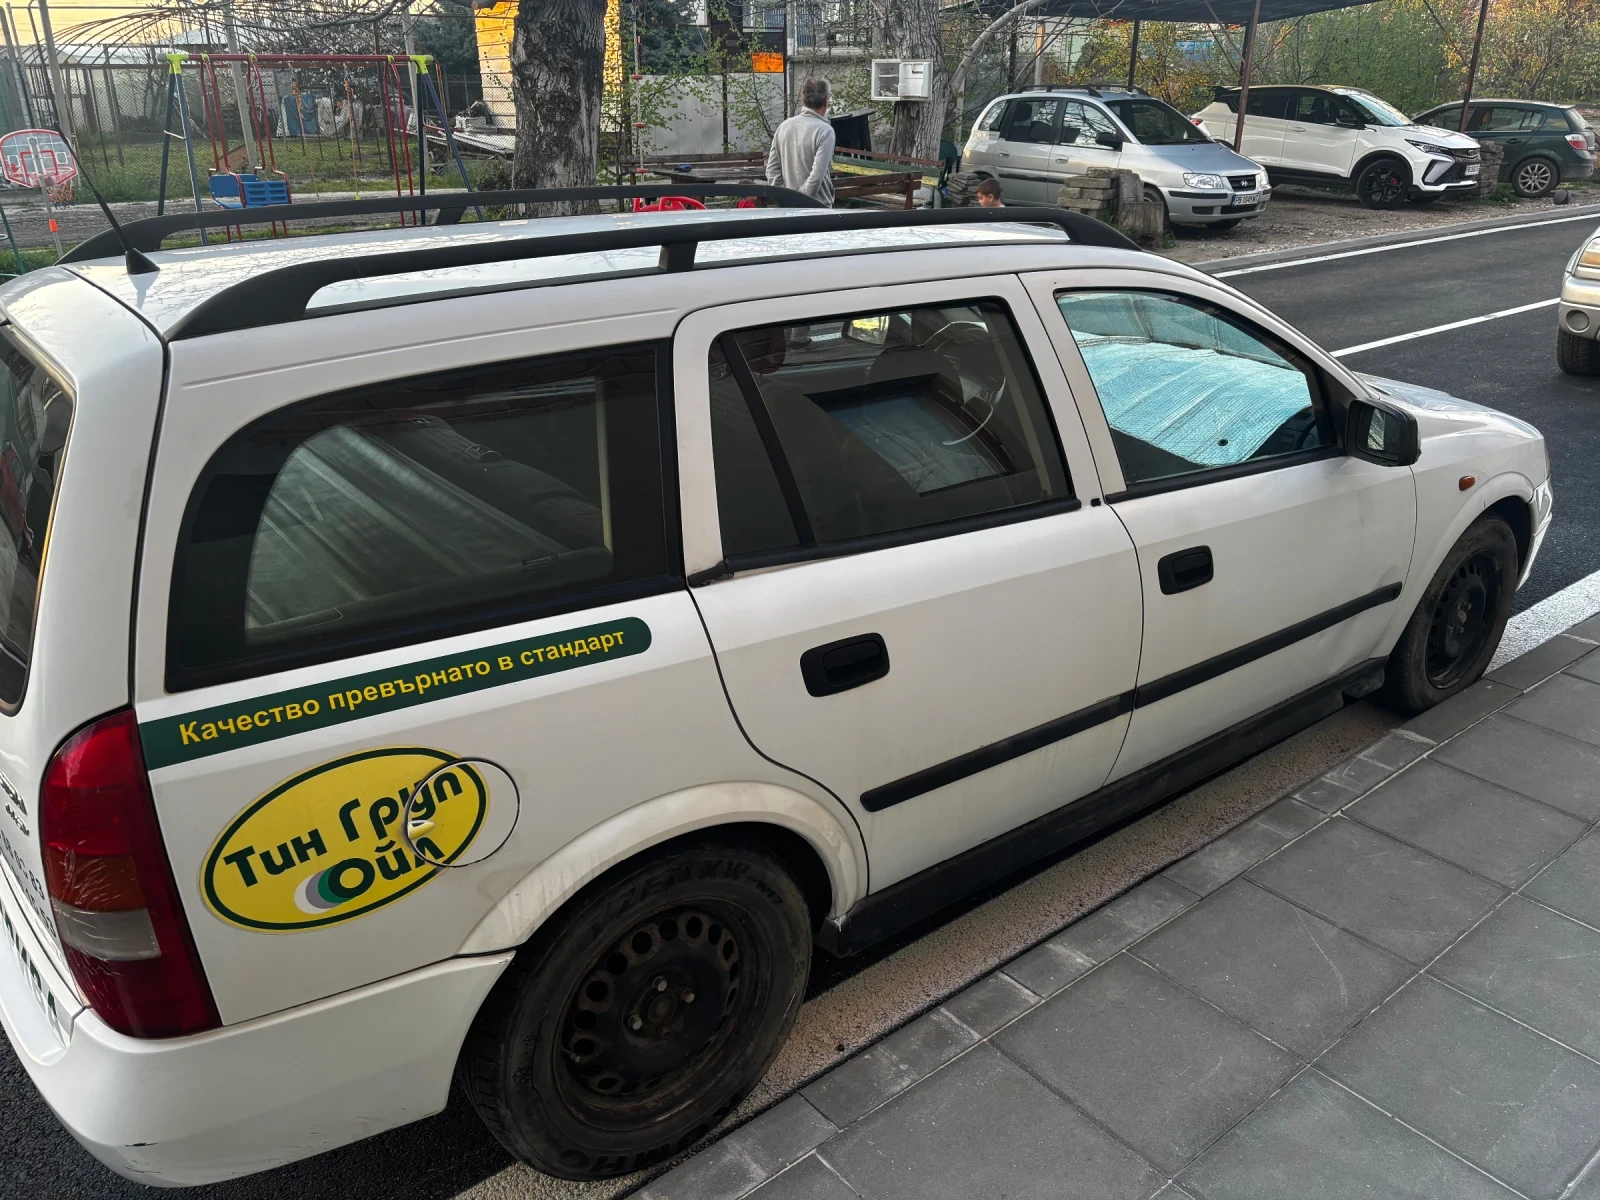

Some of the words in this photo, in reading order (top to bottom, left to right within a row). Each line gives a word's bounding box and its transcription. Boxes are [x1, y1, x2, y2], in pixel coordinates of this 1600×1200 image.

[178, 699, 320, 746] Качество
[328, 660, 491, 711] превърнато
[497, 655, 514, 671] в
[520, 631, 625, 667] стандарт
[223, 829, 327, 889] Тин
[339, 772, 464, 839] Груп
[327, 838, 446, 901] Ойл
